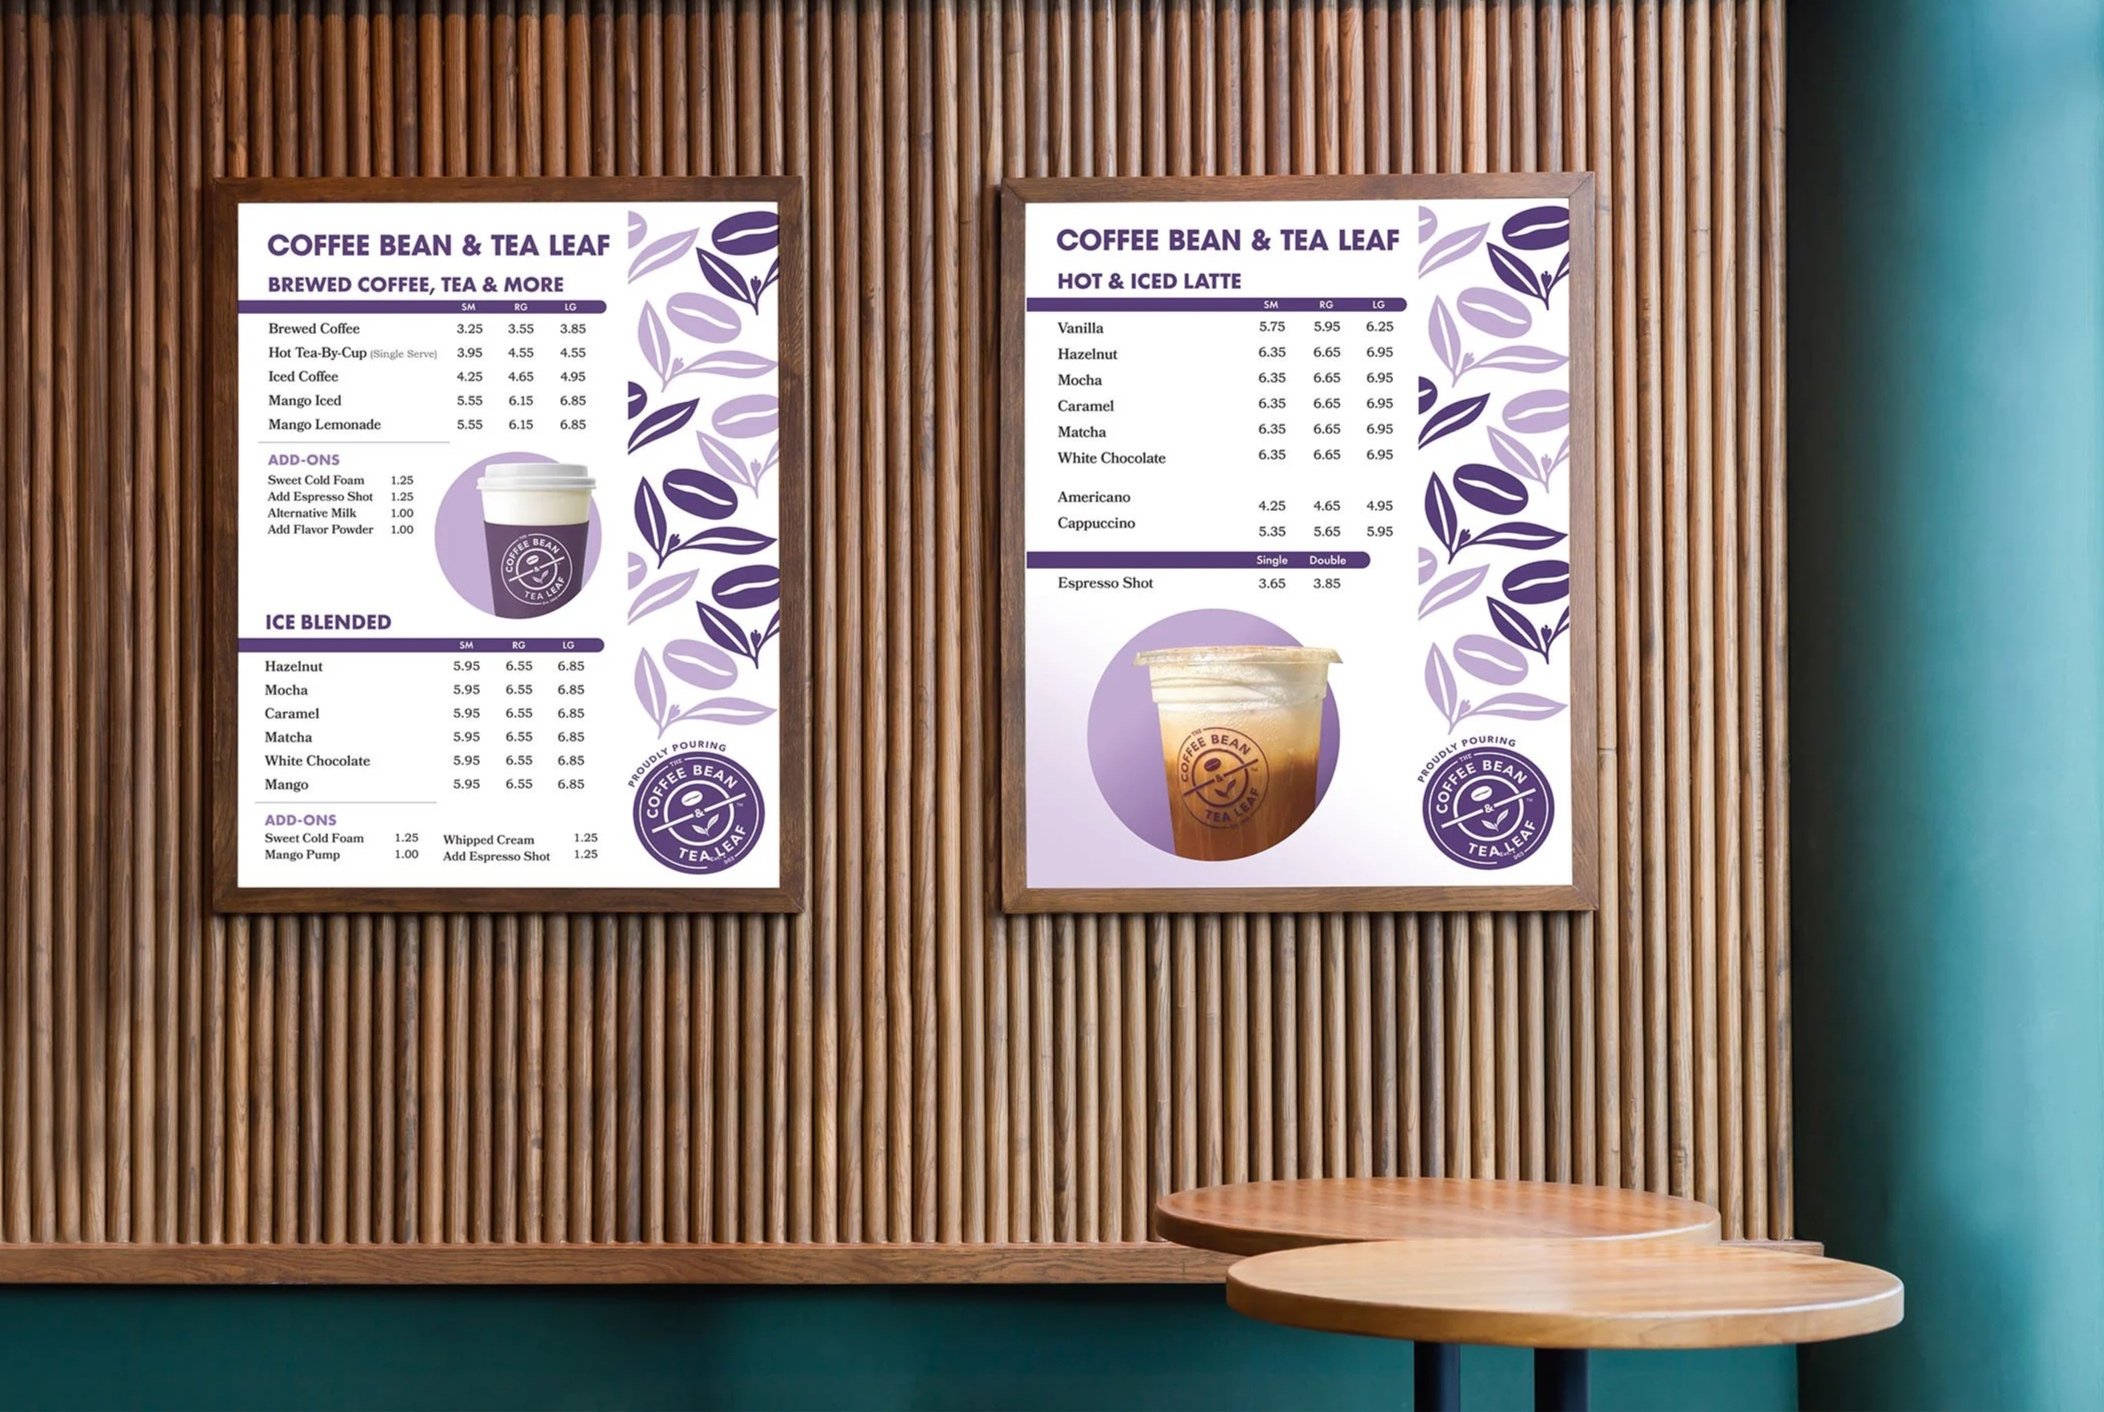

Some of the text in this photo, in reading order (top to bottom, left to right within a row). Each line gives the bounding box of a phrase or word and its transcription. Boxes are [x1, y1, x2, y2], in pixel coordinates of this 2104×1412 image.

[268, 234, 610, 256] COFFEE BEAN & TEA LEAF
[1057, 229, 1399, 251] COFFEE BEAN & TEA LEAF
[268, 276, 564, 295] BREWED COFFEE, TEA & MORE
[1058, 273, 1241, 289] HOT & ICED LATTE
[461, 302, 577, 312] SM RG LG
[1263, 300, 1386, 310] SM RG LG
[268, 322, 587, 335] Brewed Coffee 3.25 3.55 3.85
[1057, 320, 1395, 334] Vanilla 5.75 5.95 6.25
[268, 346, 587, 361] Hot Tea-By-Cup (Single Serve) 3.95 4.55 4.55
[268, 370, 586, 383] Iced Coffee 4.25 4.65 4.95
[1057, 371, 1394, 387] Mocha 6.35 6.65 6.95
[268, 394, 587, 409] Mango Iced 5.55 6.15 6.85
[268, 454, 340, 466] ADD-ONS
[1057, 448, 1394, 465] White Chocolate 6.35 6.65 6.95
[267, 474, 414, 486] Sweet Cold Foam 1.25
[267, 490, 414, 504] Add Espresso Shot 1.25
[1057, 490, 1132, 504] Americano
[267, 507, 415, 519] Alternative Milk 1.00
[1258, 499, 1394, 512] 4.25 4.65 4.95
[267, 523, 415, 535] Add Flavor Powder 1.00
[1057, 516, 1136, 532] Cappuccino
[1258, 525, 1394, 538] 5.35 5.65 5.95
[505, 538, 560, 573] COFFEE BEAN
[1256, 554, 1347, 568] Single Double
[524, 590, 544, 600] TEA
[545, 576, 565, 597] LEAF
[1058, 576, 1342, 592] Espresso Shot 3.65 3.85
[267, 614, 392, 630] ICE BLENDED
[459, 640, 575, 650] SM RG LG
[264, 660, 585, 673] Hazelnut 5.95 6.55 6.85
[264, 683, 585, 696] Mocha 5.95 6.55 6.85
[264, 754, 585, 767] White Chocolate 5.95 6.55 6.85
[627, 740, 727, 788] PROUDLY POURING
[1181, 734, 1251, 782] COFFEE BEAN
[1417, 735, 1517, 783] PROUDLY POURING
[264, 778, 585, 793] Mango 5.95 6.55 6.85
[646, 764, 738, 819] COFFEE BEAN
[1435, 759, 1528, 814] COFFEE BEAN
[1206, 787, 1259, 822] TEA LEAF
[1484, 804, 1495, 813] &
[264, 814, 337, 826] ADD-ONS
[694, 808, 705, 818] &
[264, 832, 419, 844] Sweet Cold Foam 1.25
[442, 832, 599, 848] Whipped Cream 1.25
[678, 824, 747, 862] TEA LEAF
[1468, 842, 1500, 857] TEA
[1504, 820, 1537, 853] LEAF
[264, 849, 420, 863] Mango Pump 1.00
[442, 849, 599, 864] Add Espresso Shot 1.25
